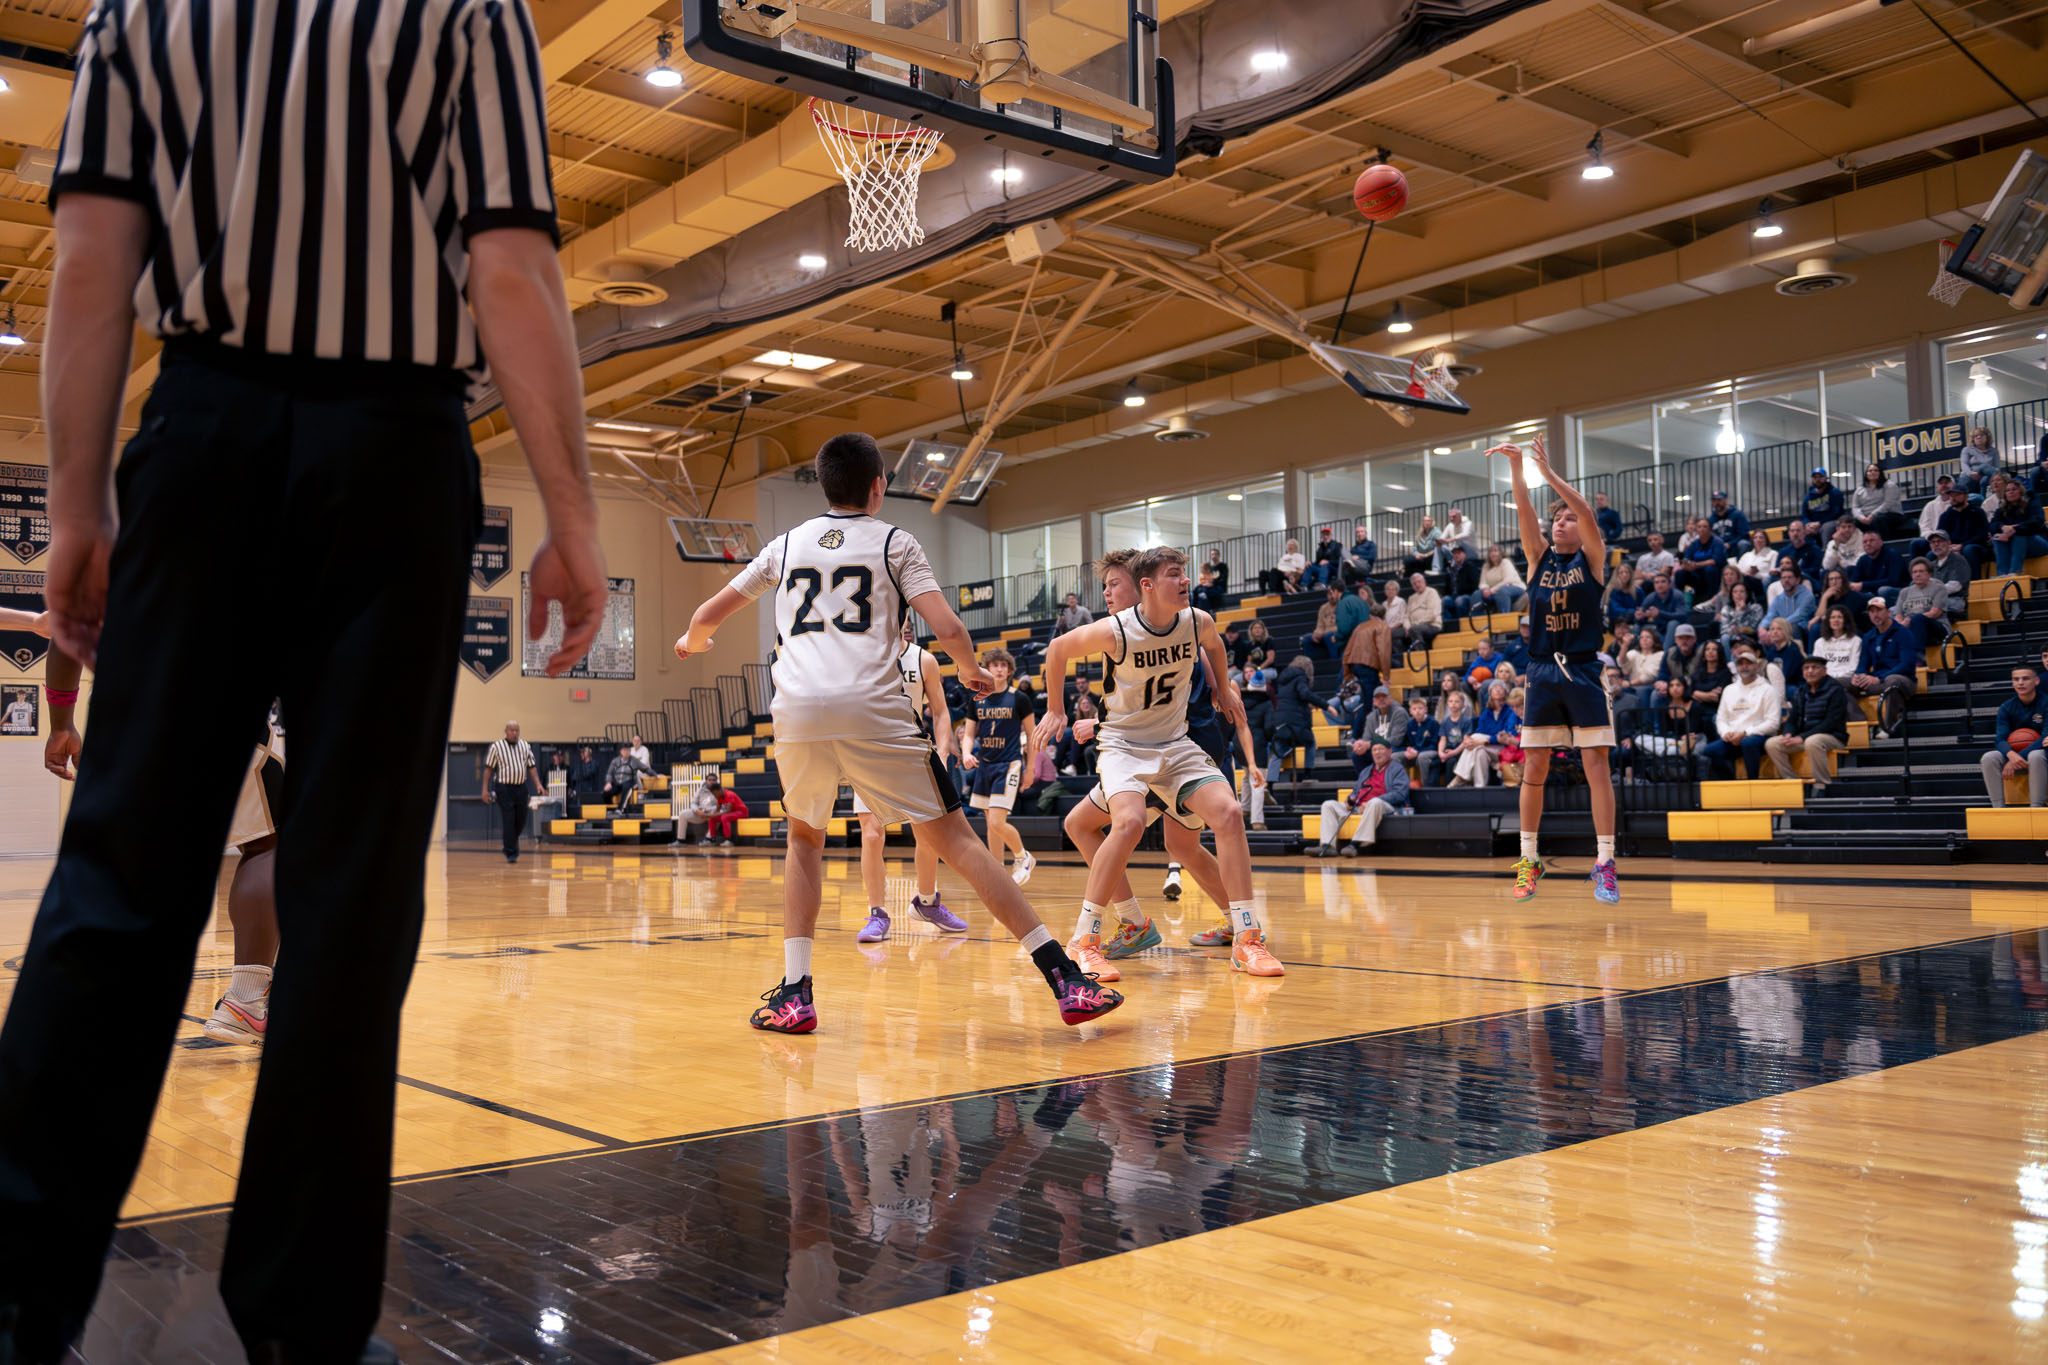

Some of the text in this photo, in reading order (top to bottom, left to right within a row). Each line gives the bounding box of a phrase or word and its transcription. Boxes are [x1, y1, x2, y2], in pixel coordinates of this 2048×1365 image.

[1878, 424, 1962, 460] HOME
[1, 466, 48, 479] BOYS SOCCE
[1, 493, 22, 503] 1990
[0, 516, 50, 526] 1989 1993
[0, 524, 50, 534] 1995 1996
[0, 532, 50, 542] 1997 2002
[22, 574, 46, 585] SOCCE
[786, 563, 874, 638] 23
[973, 585, 993, 602] BAND
[1550, 589, 1568, 612] 14
[1133, 641, 1192, 669] BURKE
[1143, 671, 1179, 710] 15
[977, 707, 1013, 720] ELKHORN
[990, 720, 996, 736] 1
